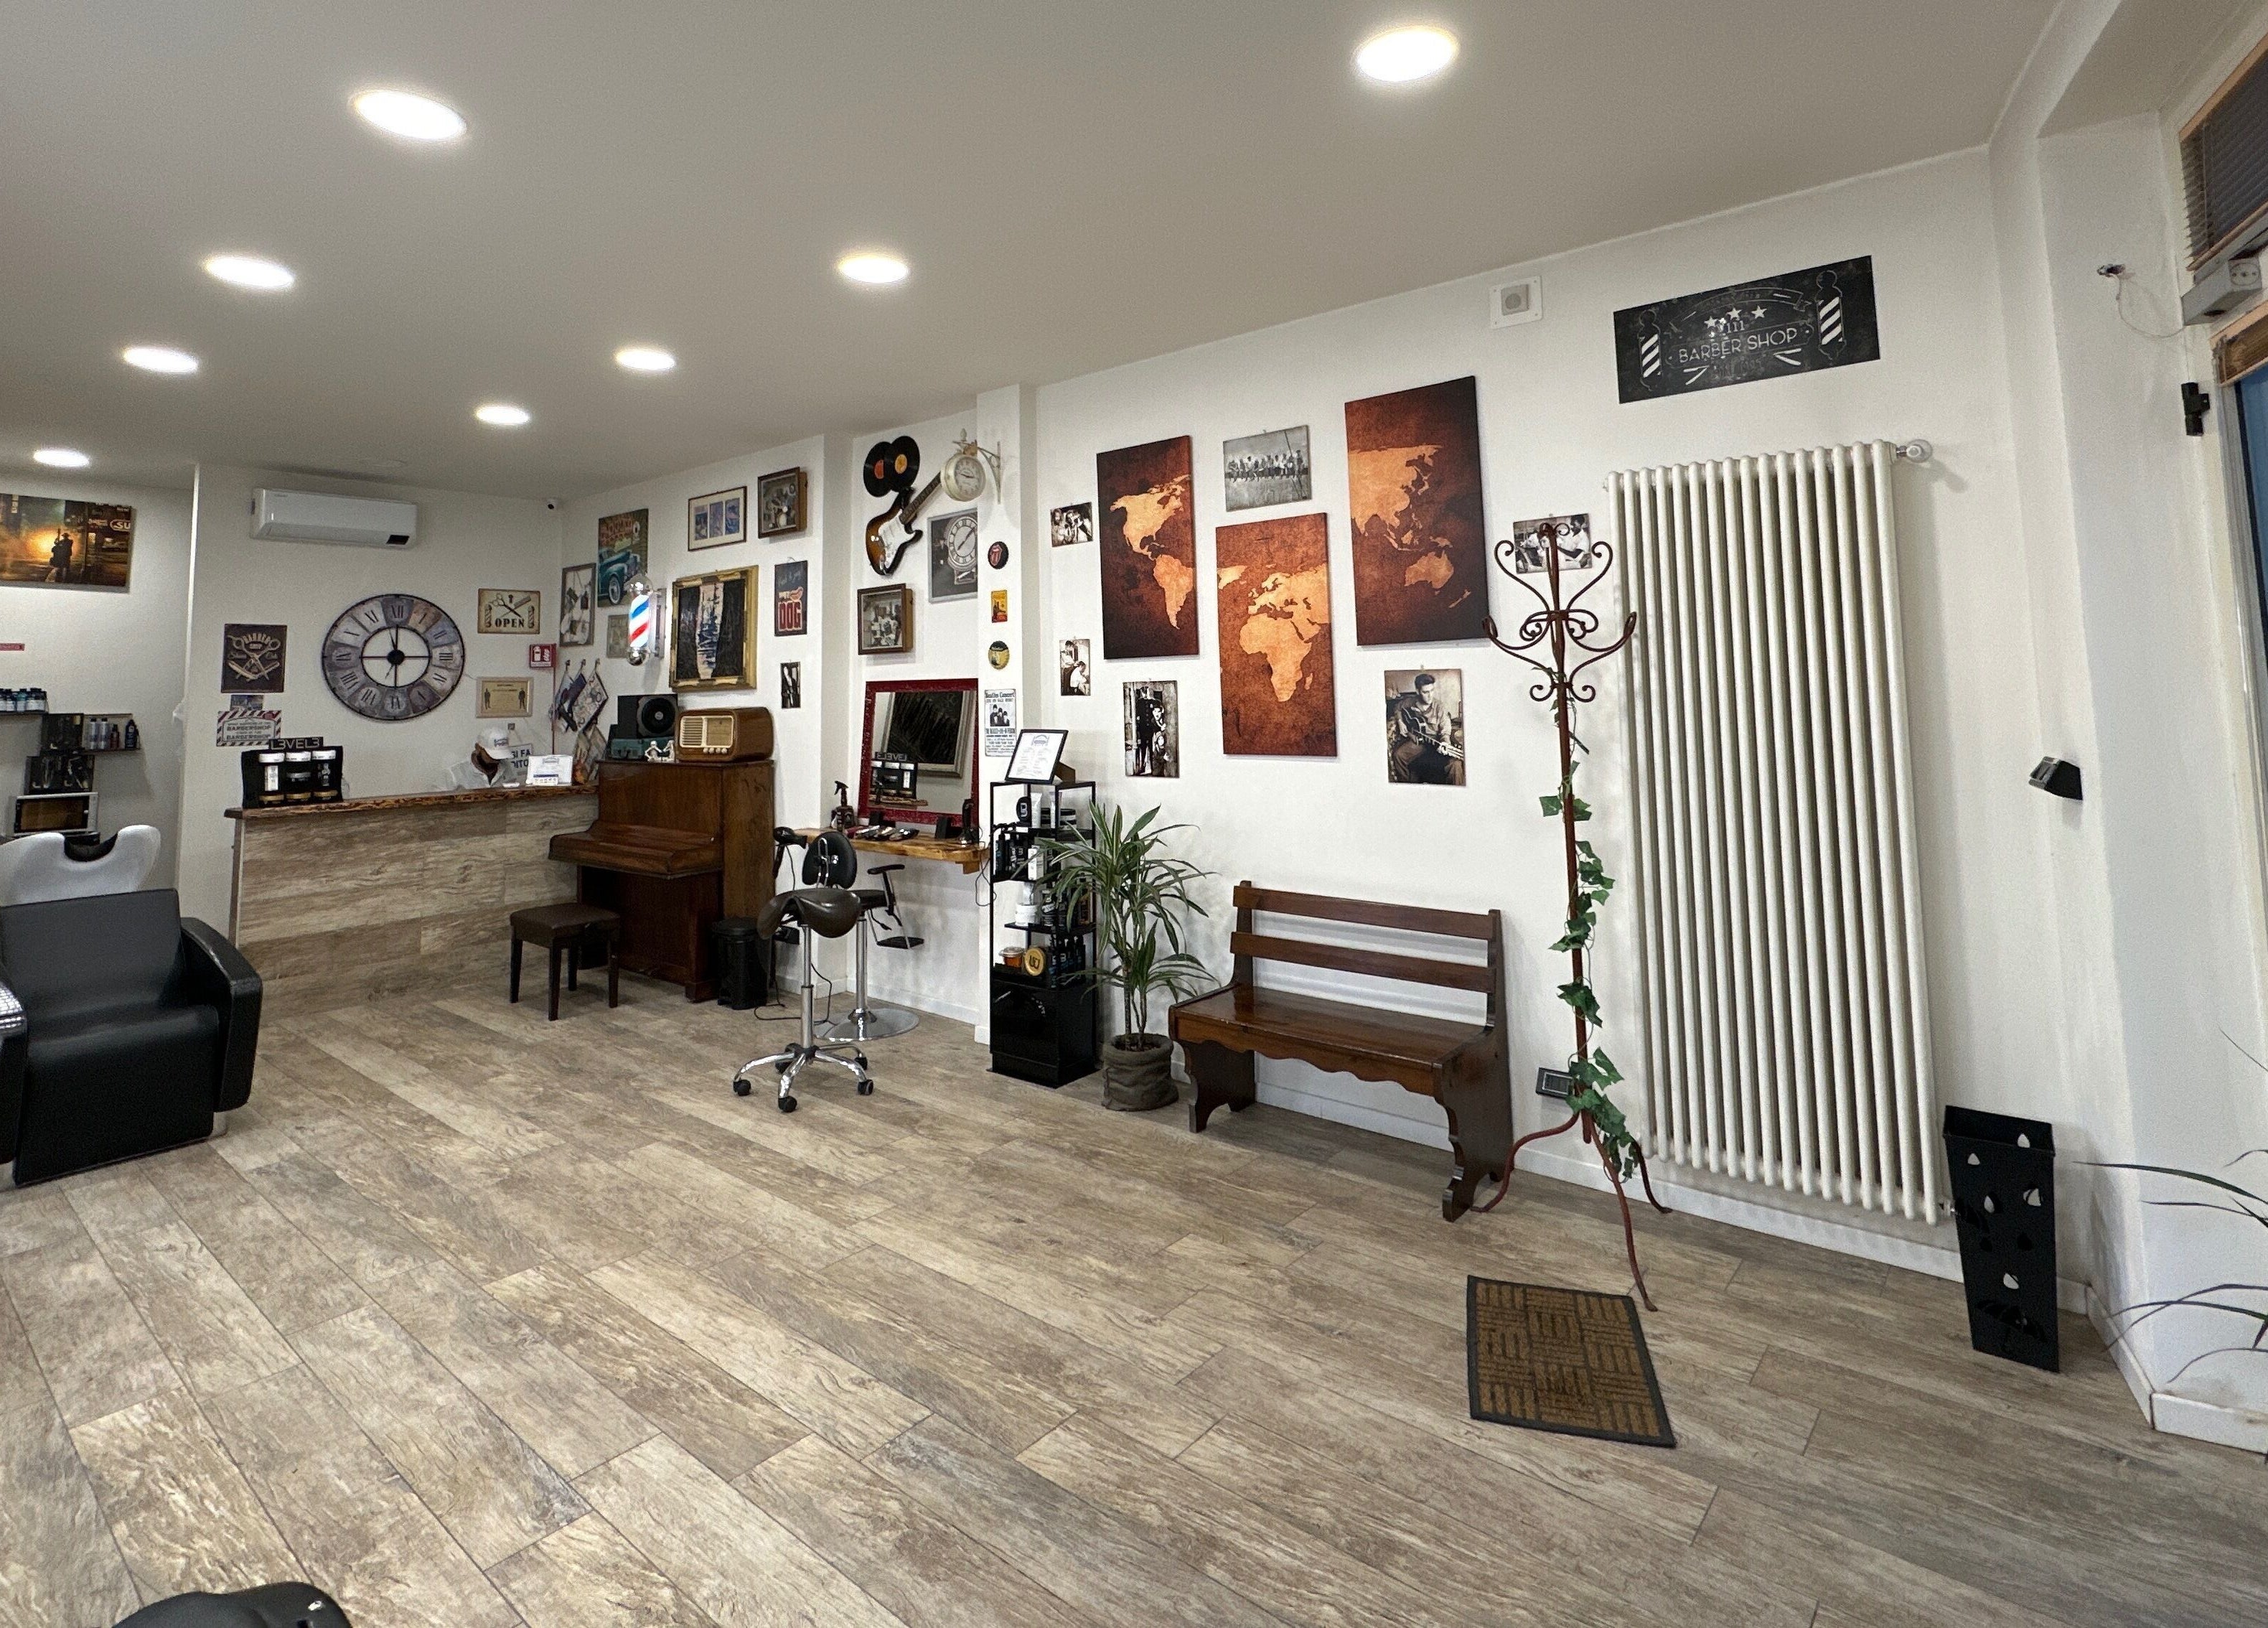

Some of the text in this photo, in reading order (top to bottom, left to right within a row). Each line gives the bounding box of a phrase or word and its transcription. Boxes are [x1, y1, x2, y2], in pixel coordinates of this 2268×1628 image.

[1679, 327, 1797, 363] BARBER SHOP
[495, 618, 525, 628] OPEN
[778, 601, 802, 631] DOG
